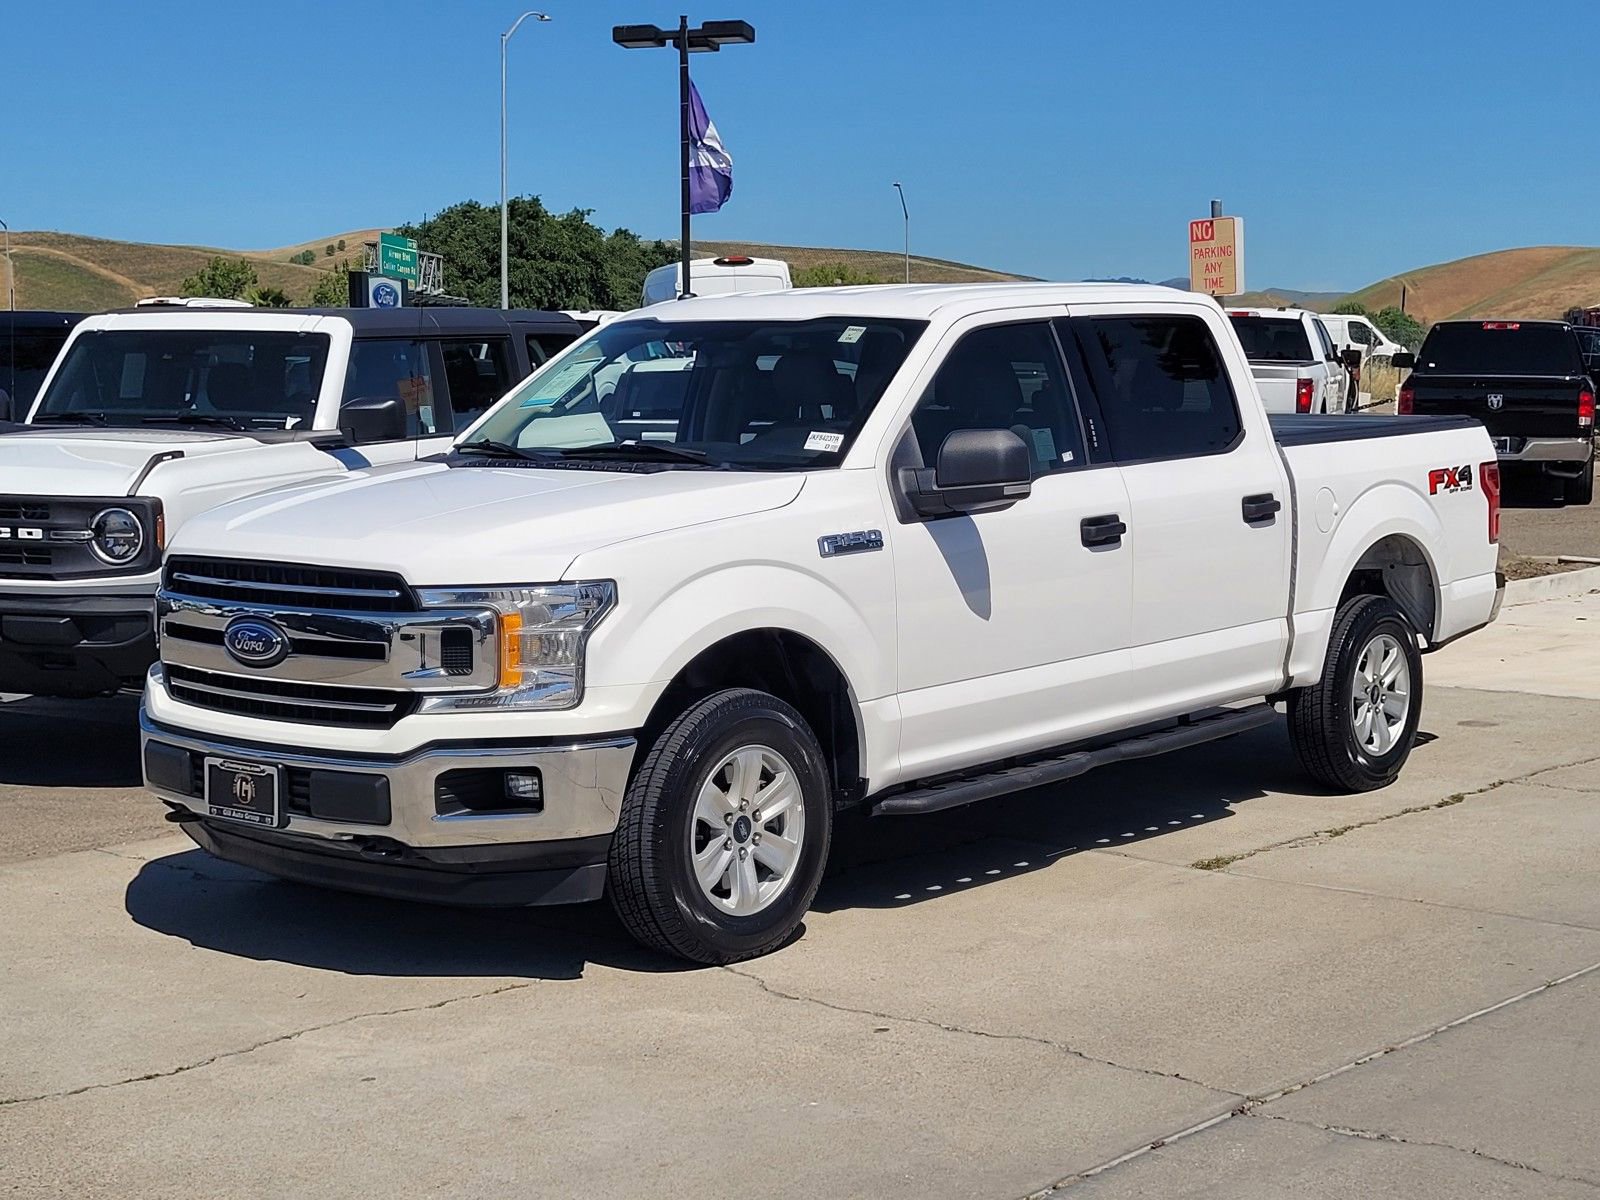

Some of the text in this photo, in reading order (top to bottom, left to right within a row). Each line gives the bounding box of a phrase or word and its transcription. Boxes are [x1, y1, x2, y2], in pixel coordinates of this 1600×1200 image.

[1192, 221, 1213, 241] NO
[1194, 245, 1233, 260] PARKING
[1204, 261, 1223, 274] ANY
[1203, 276, 1225, 289] TIME
[377, 286, 396, 306] Ford
[1428, 464, 1473, 496] FX4
[234, 630, 266, 652] Ford
